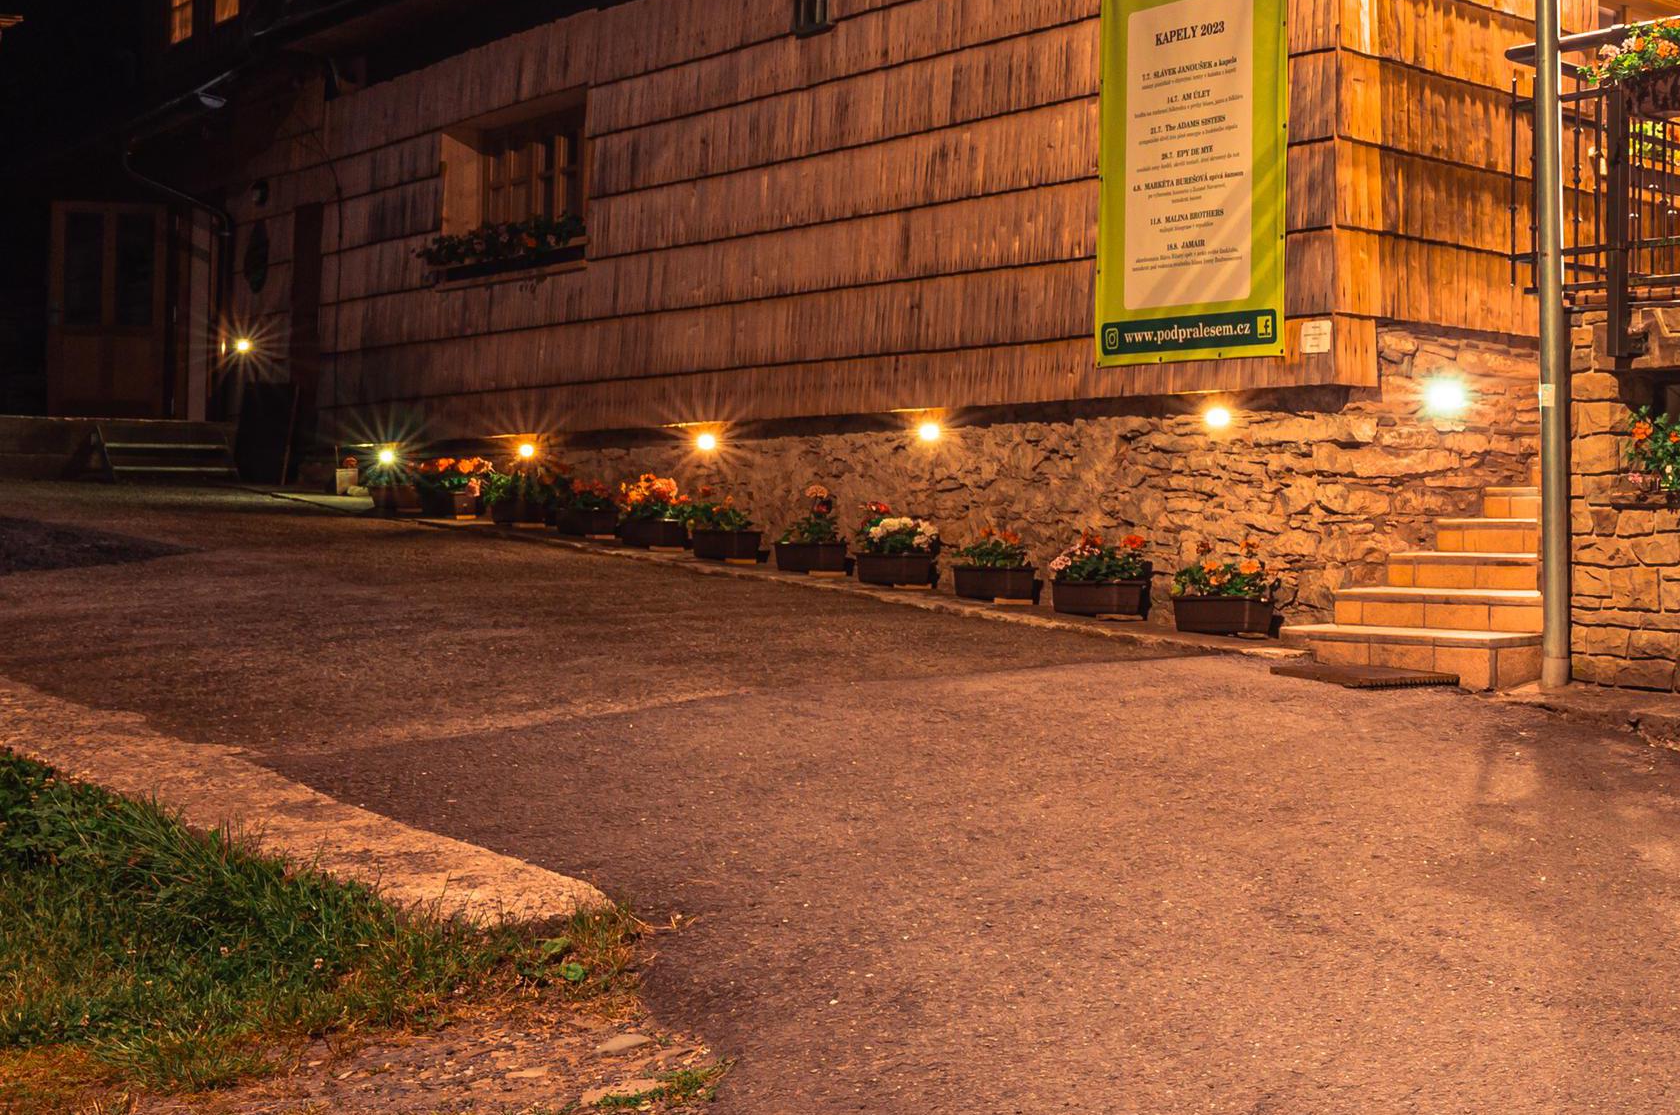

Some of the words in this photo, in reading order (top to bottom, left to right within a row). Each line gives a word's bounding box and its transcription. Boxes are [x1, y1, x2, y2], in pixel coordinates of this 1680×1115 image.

[1155, 25, 1198, 47] KAPELY
[1200, 21, 1225, 37] 2023
[1181, 93, 1192, 101] AM
[1165, 123, 1176, 132] The
[1177, 119, 1200, 130] ADAMS
[1164, 213, 1189, 223] MALINA
[1124, 321, 1250, 345] www.podpralesem.cz
